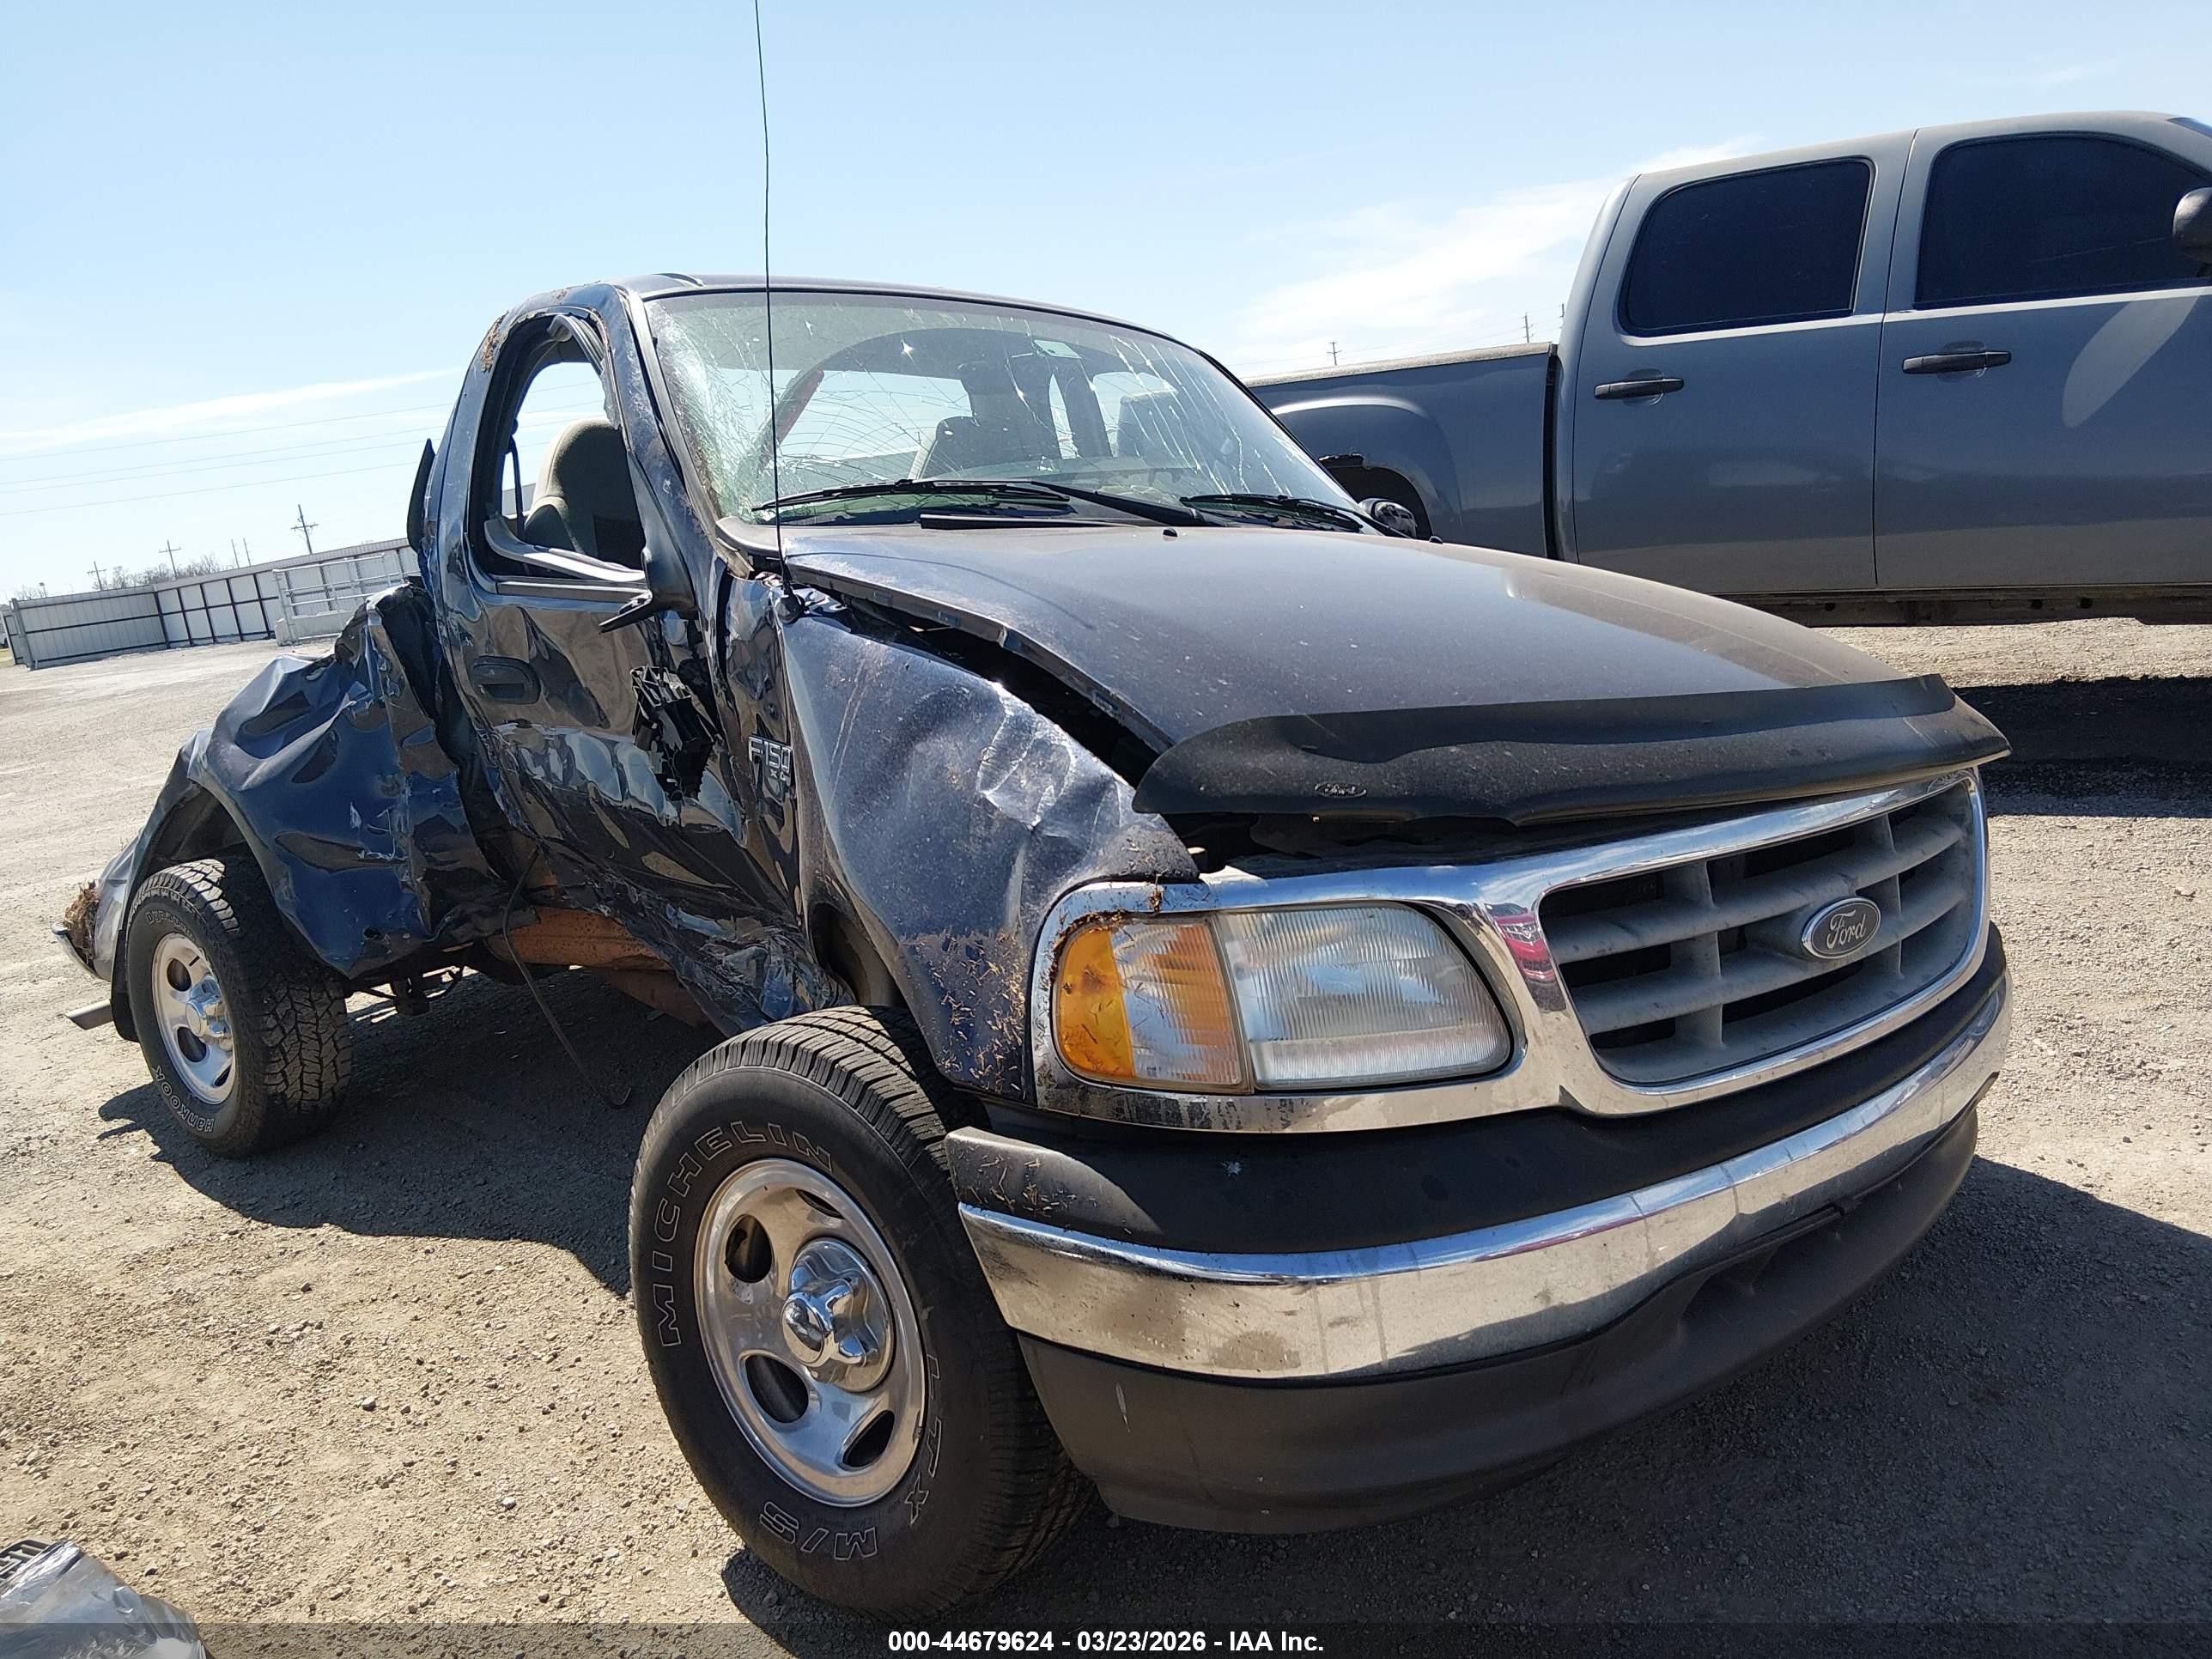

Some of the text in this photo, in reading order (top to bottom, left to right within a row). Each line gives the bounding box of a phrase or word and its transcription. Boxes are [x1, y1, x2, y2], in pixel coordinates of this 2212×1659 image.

[1826, 909, 1867, 950] Ford
[652, 1121, 832, 1347] MICHELIN
[759, 1353, 942, 1561] LTX M/S
